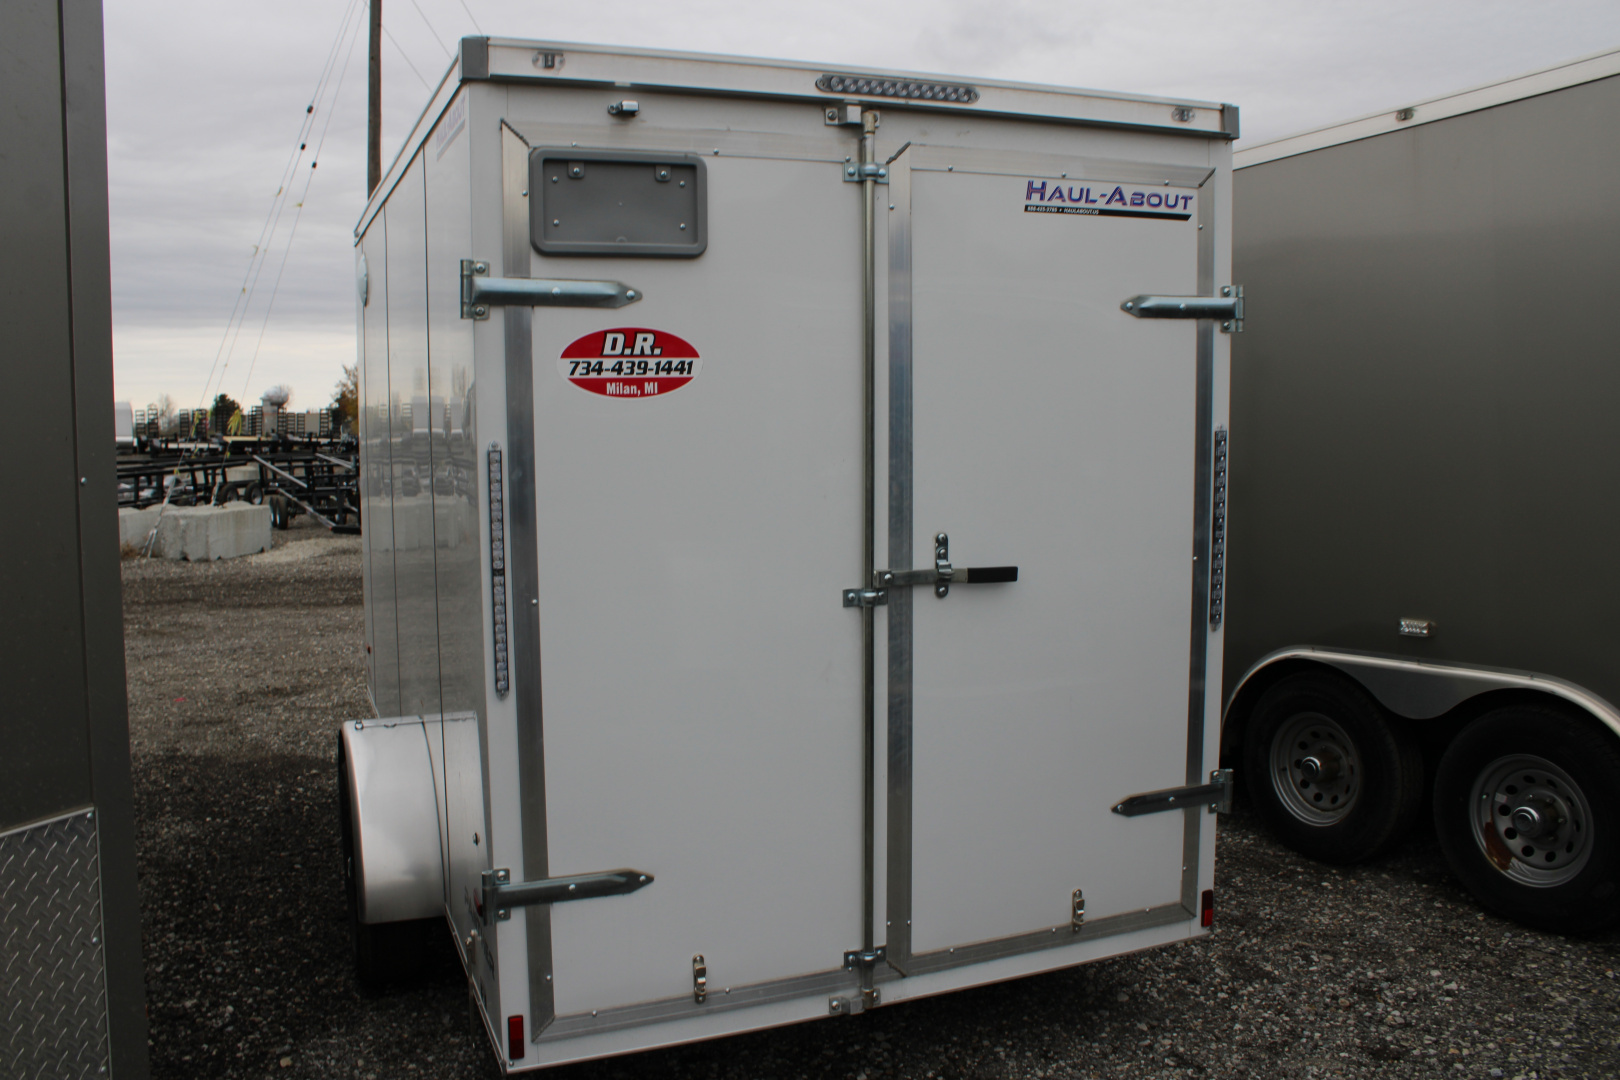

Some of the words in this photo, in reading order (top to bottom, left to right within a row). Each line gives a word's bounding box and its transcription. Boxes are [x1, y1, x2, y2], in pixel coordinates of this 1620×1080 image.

[1025, 180, 1194, 210] HAUL-ABOUT
[602, 332, 662, 356] D.R.
[569, 360, 694, 376] 734-439-1441
[606, 382, 641, 396] Milan,
[644, 381, 658, 394] MI
